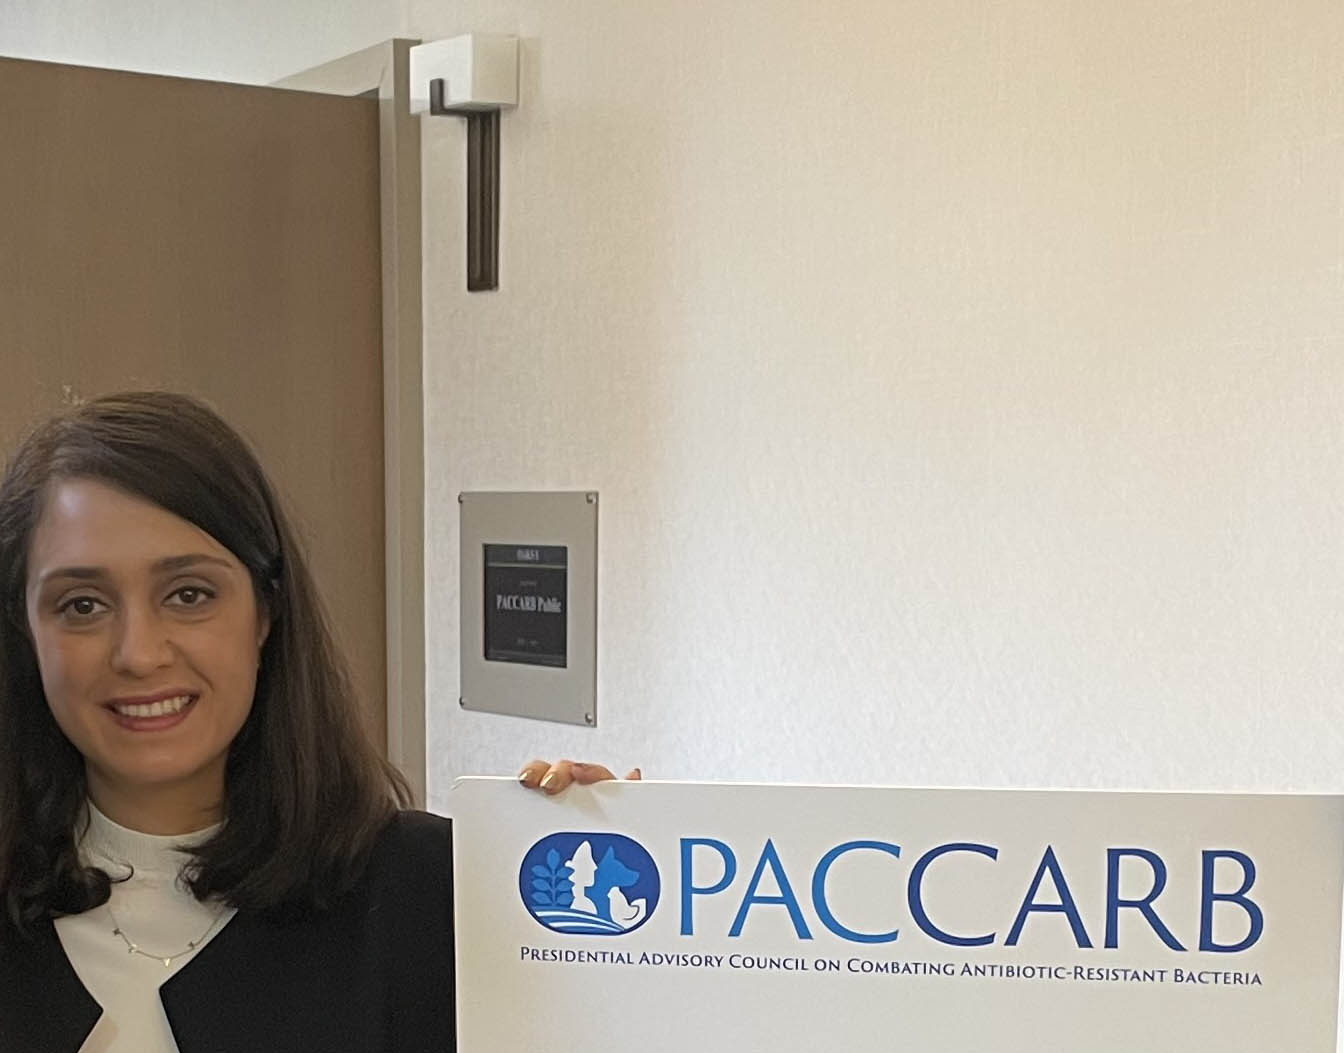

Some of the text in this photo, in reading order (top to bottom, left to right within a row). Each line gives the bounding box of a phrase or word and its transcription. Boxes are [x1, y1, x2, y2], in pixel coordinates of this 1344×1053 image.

[679, 837, 1263, 953] PACCARB
[520, 946, 634, 965] PRESIDENTIAL
[638, 951, 723, 968] ADVISORY
[729, 954, 809, 971] COUNCIL
[847, 958, 955, 977] COMBATING
[1174, 968, 1263, 985] BACTERIA
